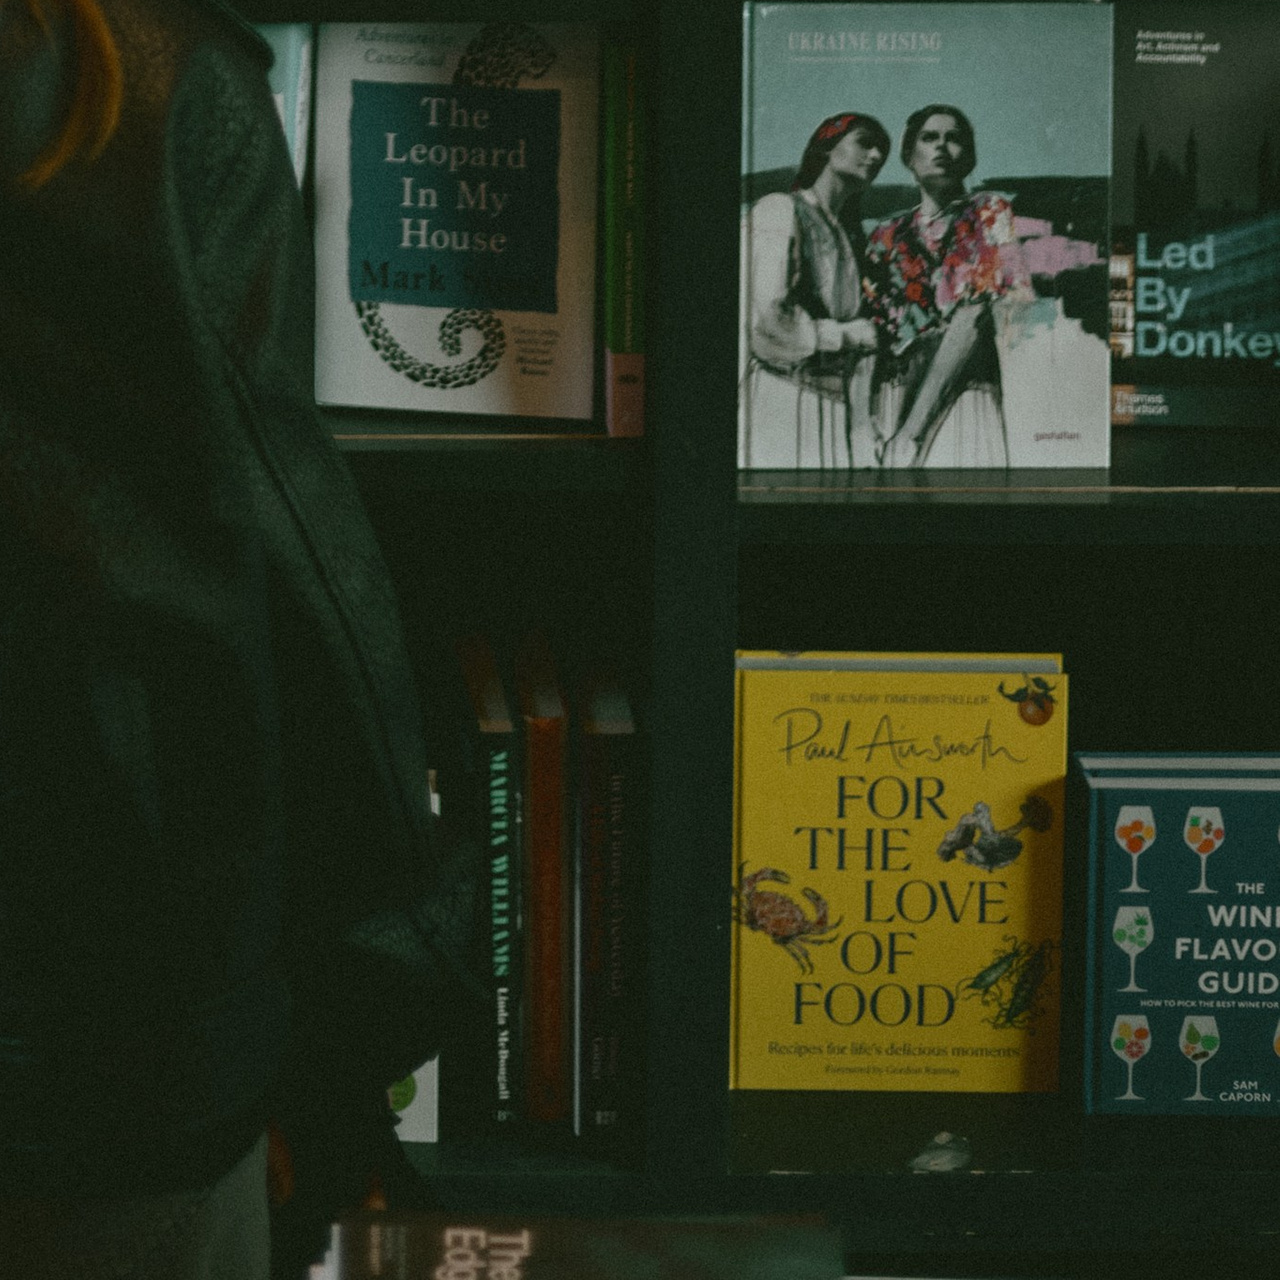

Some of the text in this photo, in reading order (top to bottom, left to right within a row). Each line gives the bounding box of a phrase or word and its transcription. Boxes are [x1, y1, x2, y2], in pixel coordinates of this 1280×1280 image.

[422, 98, 490, 129] The
[384, 132, 526, 171] Leopard
[402, 177, 508, 217] In My
[399, 218, 507, 253] House
[1136, 233, 1215, 271] Led
[1135, 277, 1191, 320] By
[837, 776, 947, 819] FOR
[794, 827, 911, 871] THE
[865, 881, 1010, 924] LOVE
[1236, 882, 1265, 894] THE
[840, 931, 917, 974] OF
[793, 984, 956, 1027] FOOD
[1219, 1092, 1271, 1102] CAPORN
[1232, 1080, 1258, 1090] SAM
